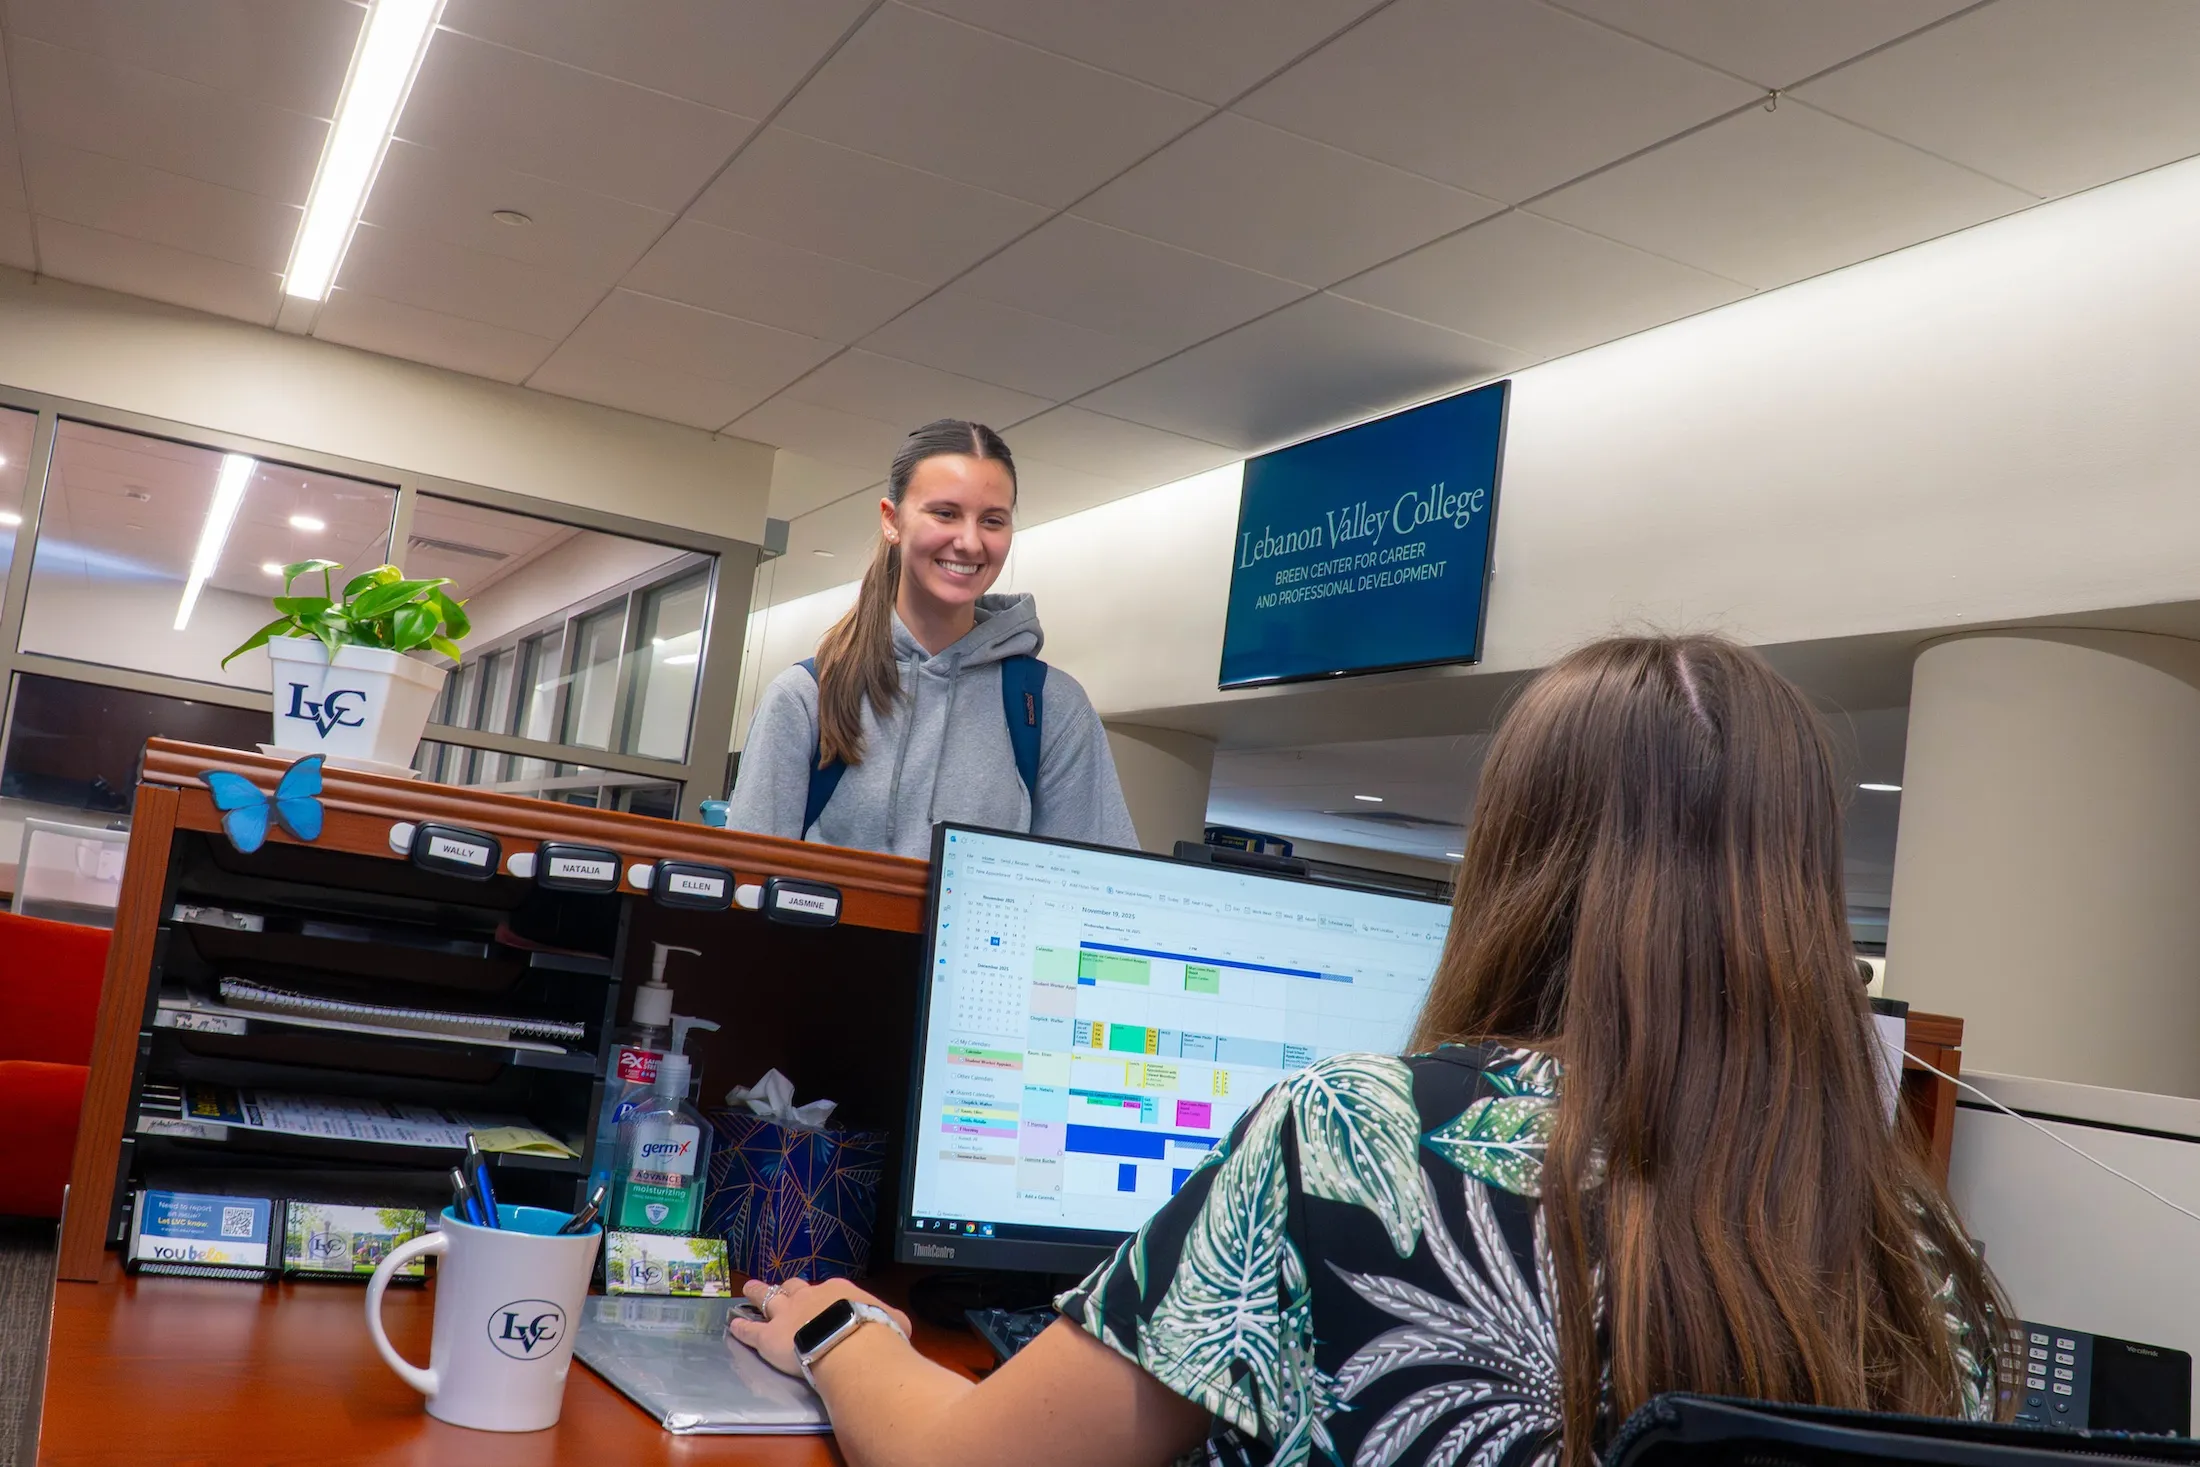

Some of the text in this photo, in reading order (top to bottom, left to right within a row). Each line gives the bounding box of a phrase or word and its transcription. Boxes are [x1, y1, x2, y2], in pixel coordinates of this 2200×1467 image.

[1239, 482, 1485, 569] Lebanon Valley College
[1275, 542, 1426, 585] BREEN CENTER FOR CAREER
[1255, 561, 1447, 610] AND PROFESSIONAL DEVELOPMENT
[285, 682, 366, 739] LVC
[443, 844, 475, 858] WALLY
[563, 864, 600, 875] NATALIA
[682, 880, 711, 891] ELLEN
[788, 897, 825, 910] JASMINE
[1082, 906, 1136, 920] November 19, 2025
[621, 1052, 642, 1069] 2X
[633, 1184, 686, 1198] moisturizing
[158, 1201, 178, 1210] Need
[189, 1204, 212, 1212] report
[171, 1218, 186, 1226] LVC
[154, 1246, 187, 1260] YOU
[913, 1243, 955, 1259] ThinkCentre
[499, 1312, 559, 1353] LVC
